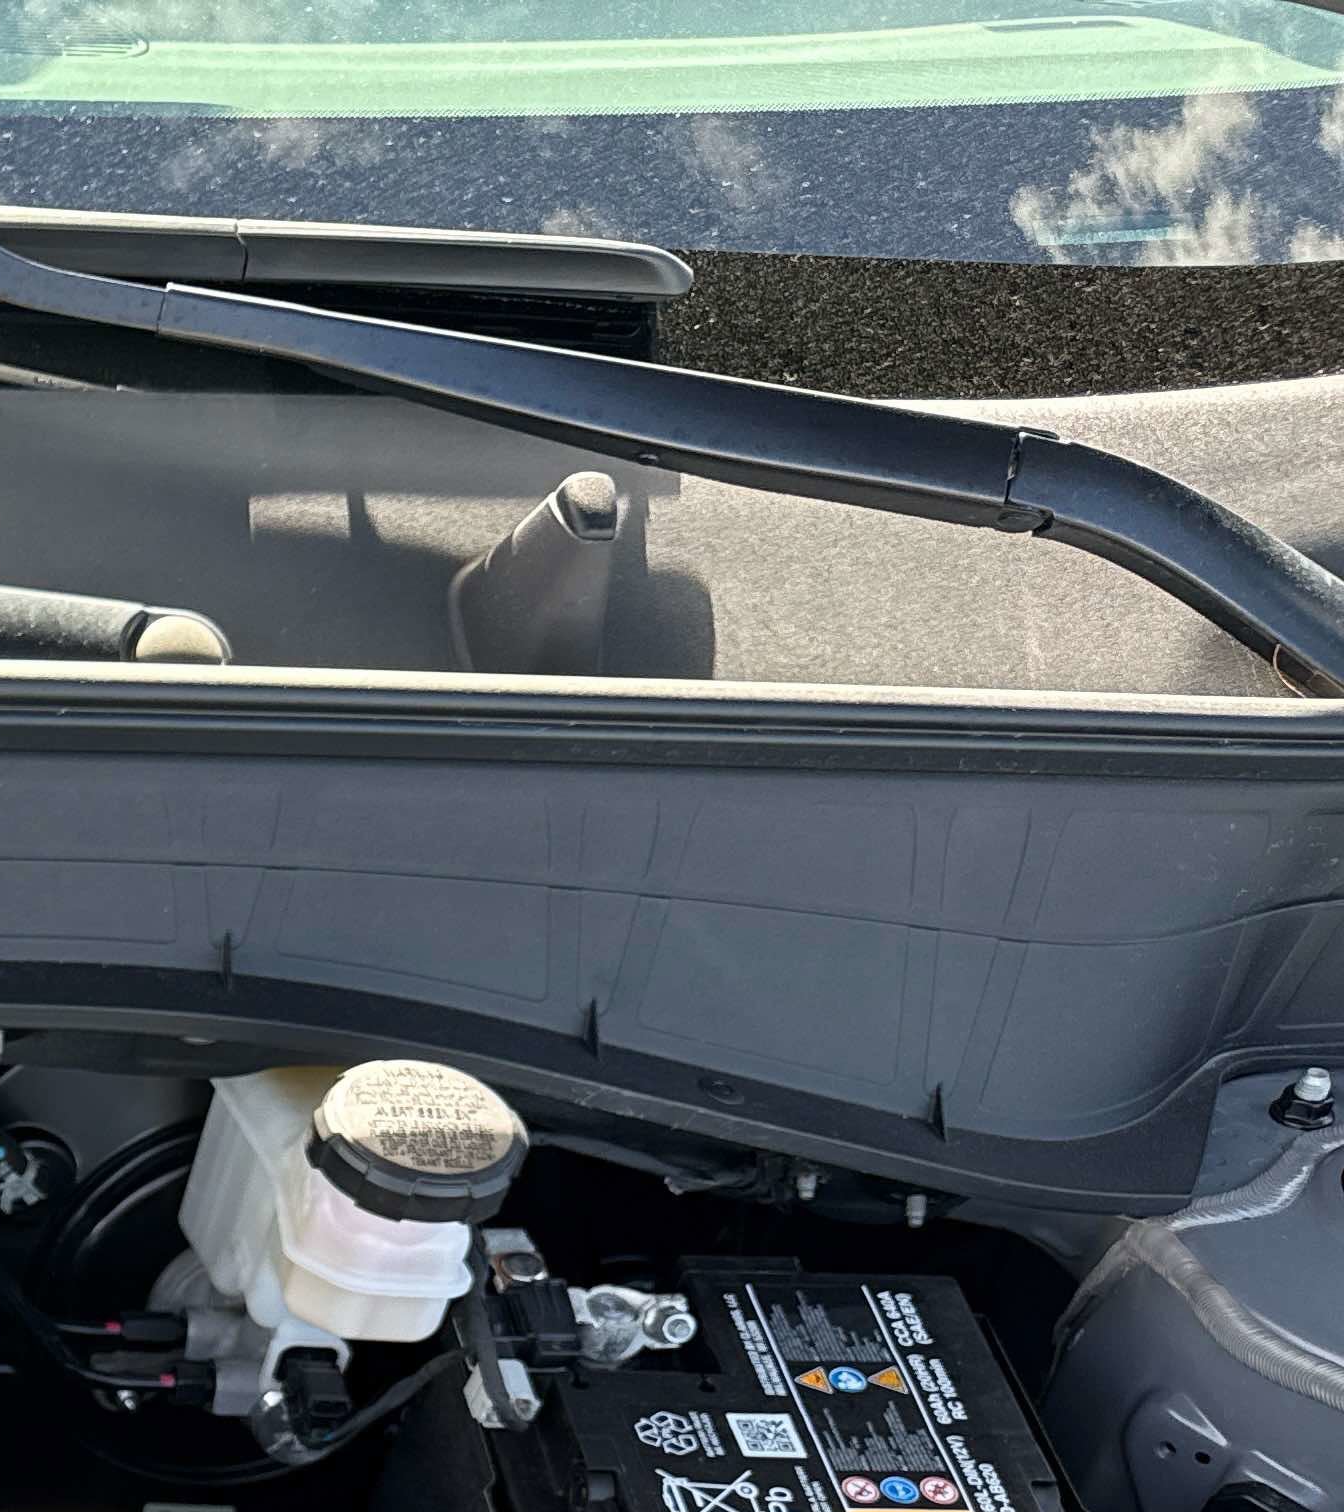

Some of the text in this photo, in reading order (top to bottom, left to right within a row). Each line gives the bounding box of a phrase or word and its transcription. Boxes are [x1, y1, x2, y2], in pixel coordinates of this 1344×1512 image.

[895, 1293, 932, 1342] (SAE/EN)
[890, 1320, 913, 1345] CCA
[946, 1401, 967, 1419] RC
